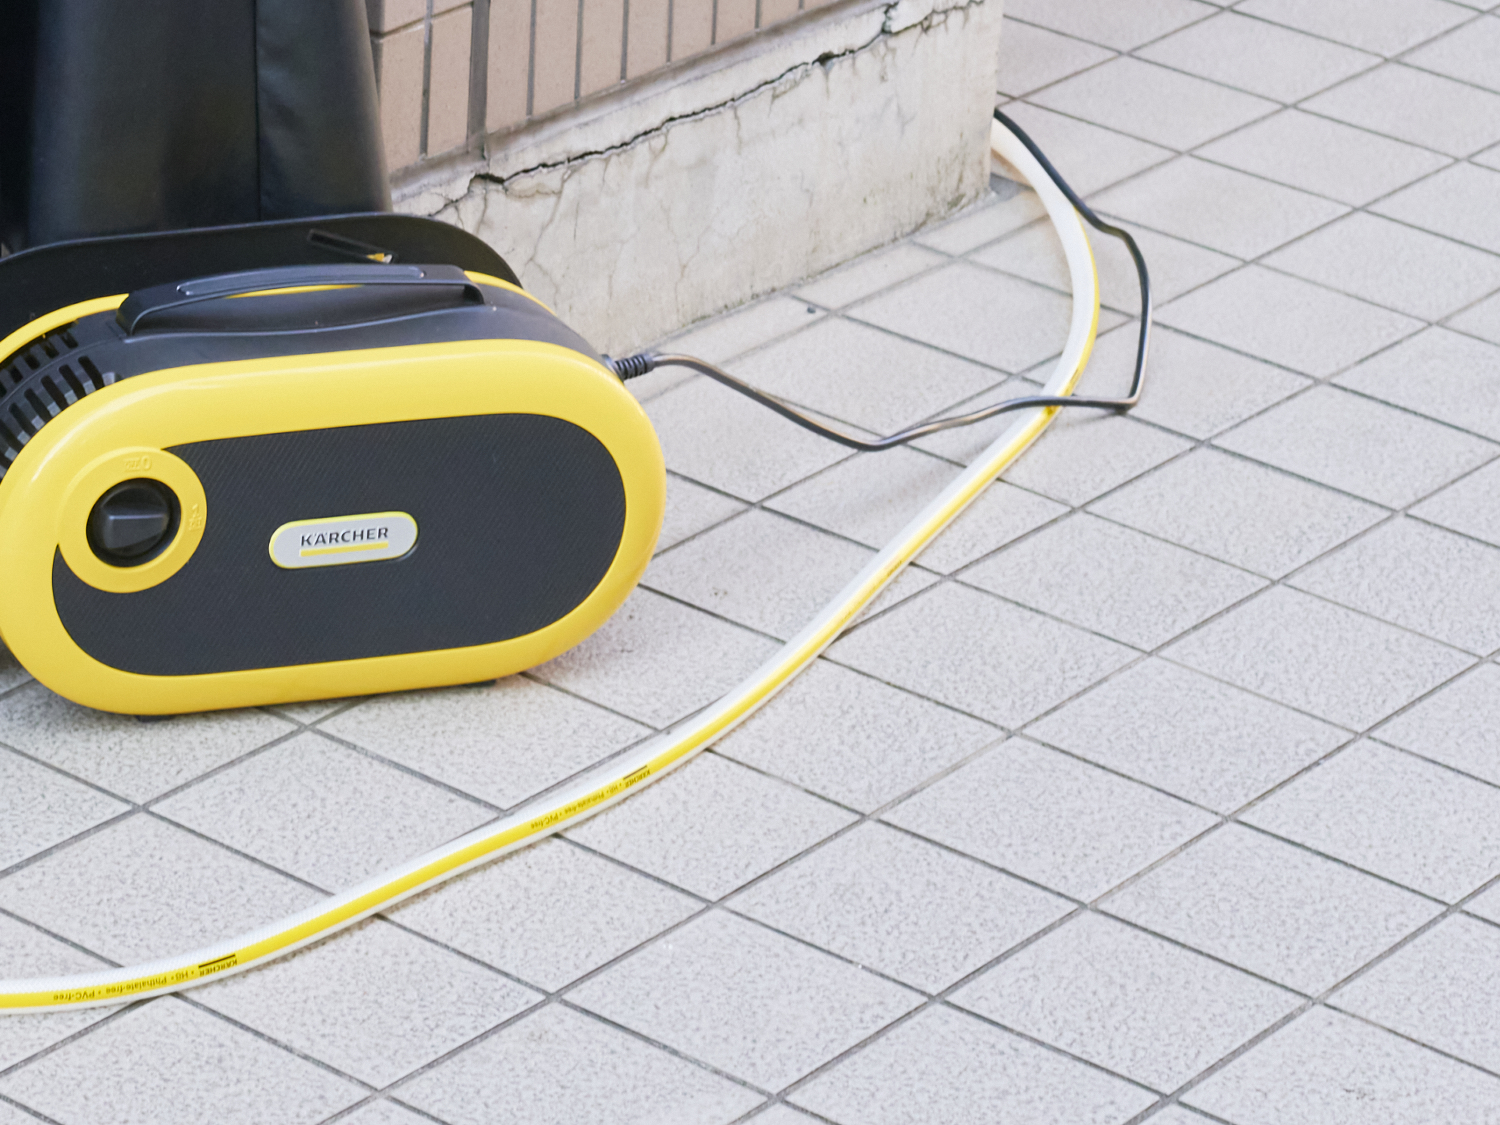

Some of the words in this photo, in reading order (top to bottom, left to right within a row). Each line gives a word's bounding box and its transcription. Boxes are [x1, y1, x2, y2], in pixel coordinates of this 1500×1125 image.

[300, 526, 389, 547] KÄRCHER
[53, 989, 95, 1001] PVC-free
[105, 976, 168, 995] Phthalate-free
